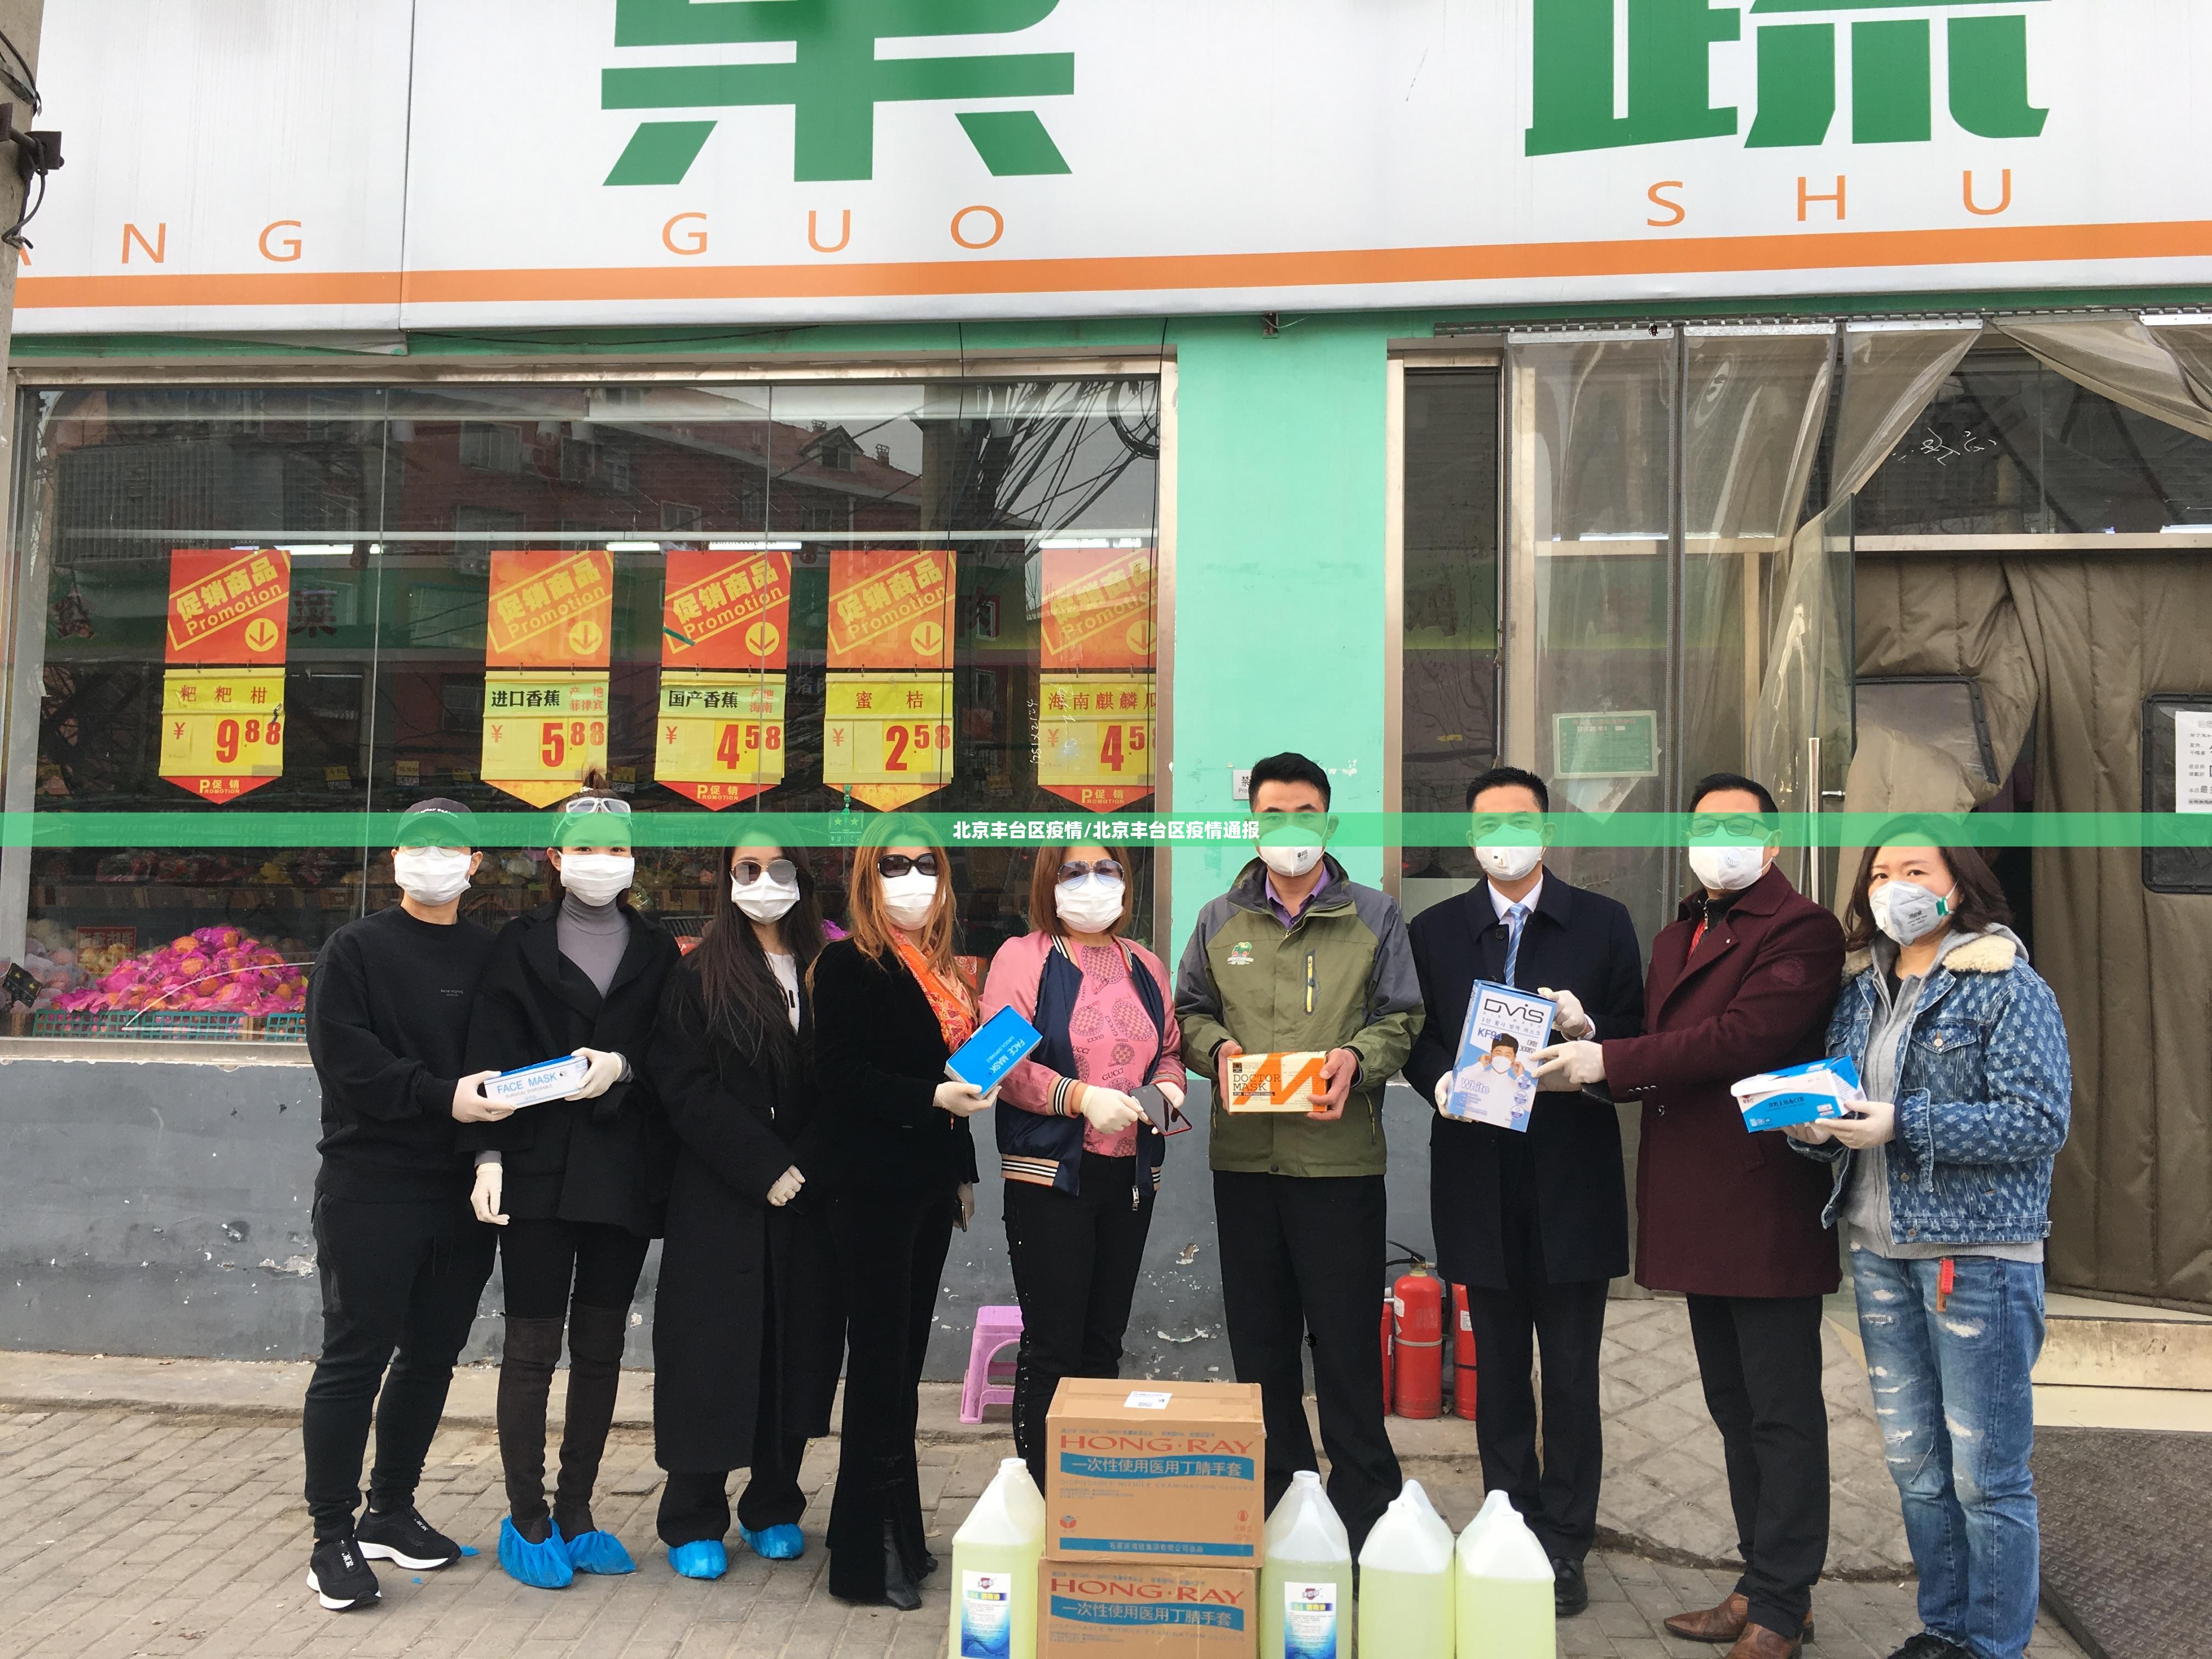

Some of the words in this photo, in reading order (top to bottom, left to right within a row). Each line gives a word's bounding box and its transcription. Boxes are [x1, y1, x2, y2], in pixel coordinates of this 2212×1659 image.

[1646, 168, 2012, 227] SHU
[662, 205, 1005, 255] GUO
[17, 220, 303, 266] NG
[177, 556, 278, 622] 促销商品
[496, 558, 601, 624] 促销商品
[673, 559, 778, 624] 促销商品
[837, 557, 944, 625] 促销商品
[187, 583, 282, 636] Promotion
[508, 586, 606, 639] Promotion
[683, 586, 783, 639] Promotion
[848, 585, 947, 640] Promotion
[180, 685, 267, 704] 粑粑柑
[492, 690, 560, 708] 进口香蕉
[669, 690, 738, 709] 国产香蕉
[856, 690, 923, 709] 蜜桔
[212, 779, 240, 789] 促销
[710, 785, 738, 795] 促销
[1094, 789, 1124, 799] 促销
[1105, 1015, 1118, 1036] GUCCI
[1007, 1038, 1026, 1056] FACE
[989, 1054, 1009, 1074] MASK
[1102, 1067, 1124, 1081] GUCCI
[497, 1081, 522, 1094] FACE
[528, 1071, 558, 1086] MASK
[1233, 1083, 1267, 1091] MASK
[1461, 1077, 1490, 1094] White
[1073, 1458, 1242, 1477] 一次性使用医用丁腈手套
[1063, 1602, 1231, 1627] 一次性使用医用丁腈手套
